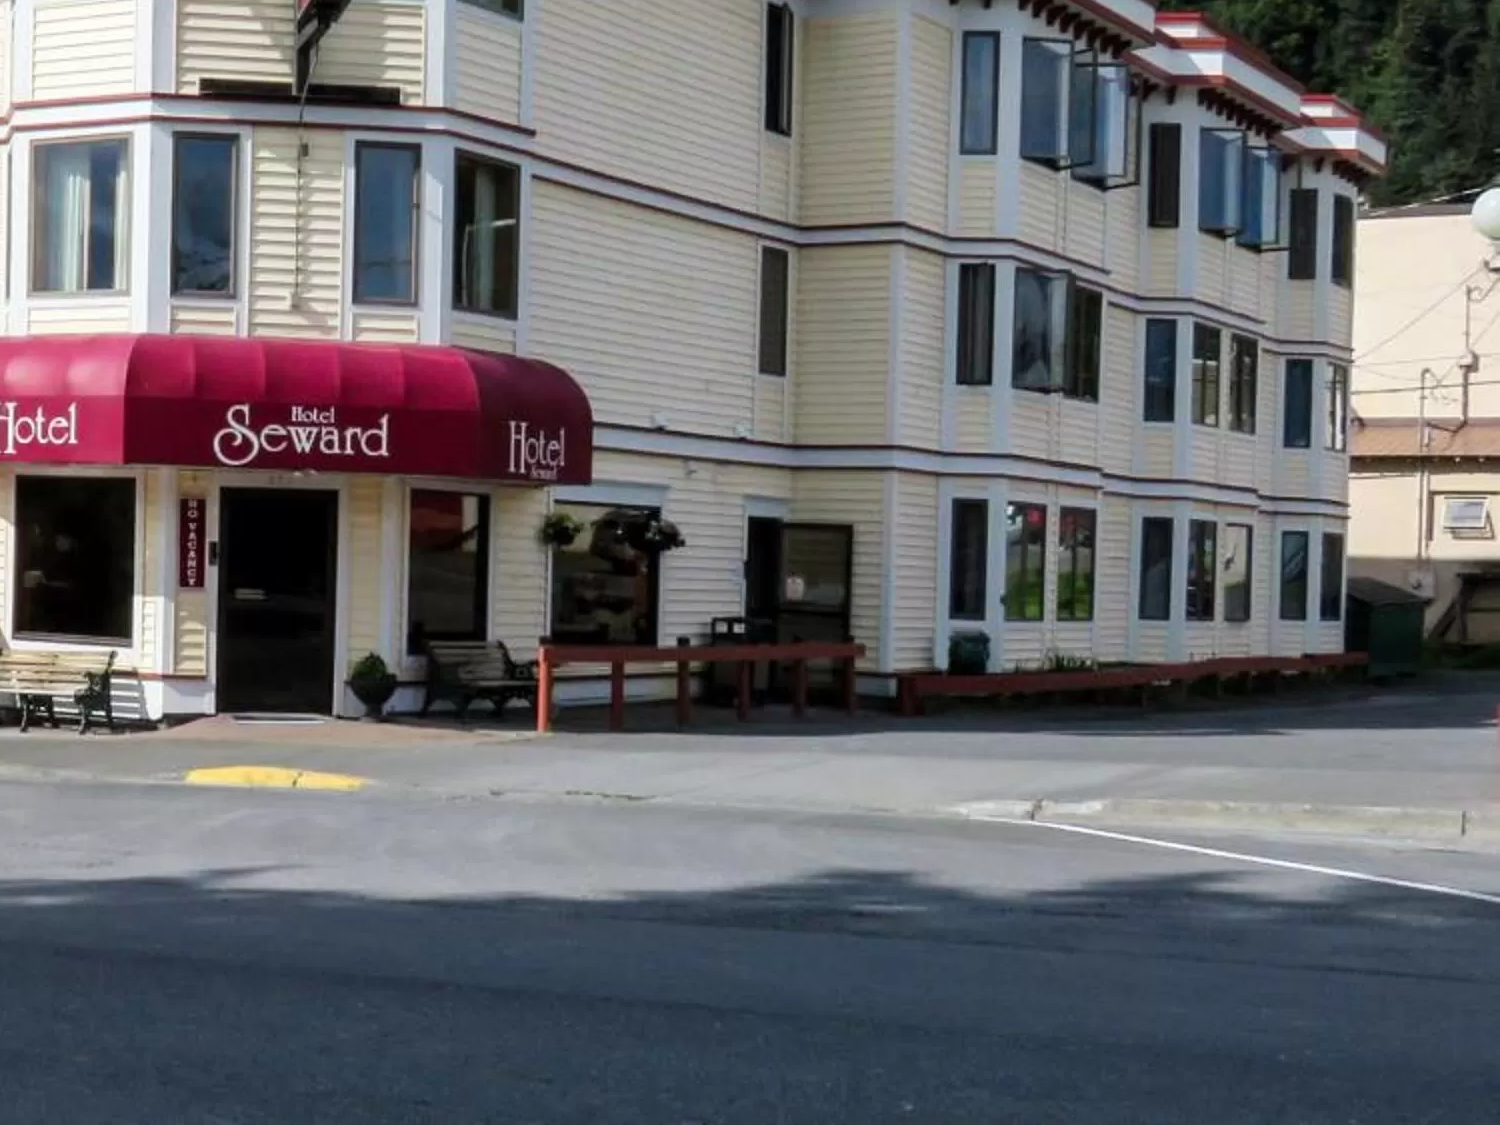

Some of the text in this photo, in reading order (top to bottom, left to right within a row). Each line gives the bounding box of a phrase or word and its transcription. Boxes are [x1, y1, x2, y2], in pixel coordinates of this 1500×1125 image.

[213, 403, 389, 466] Seward
[291, 405, 336, 424] Hotel
[508, 420, 566, 474] Hotel
[187, 522, 198, 586] VACANCY
